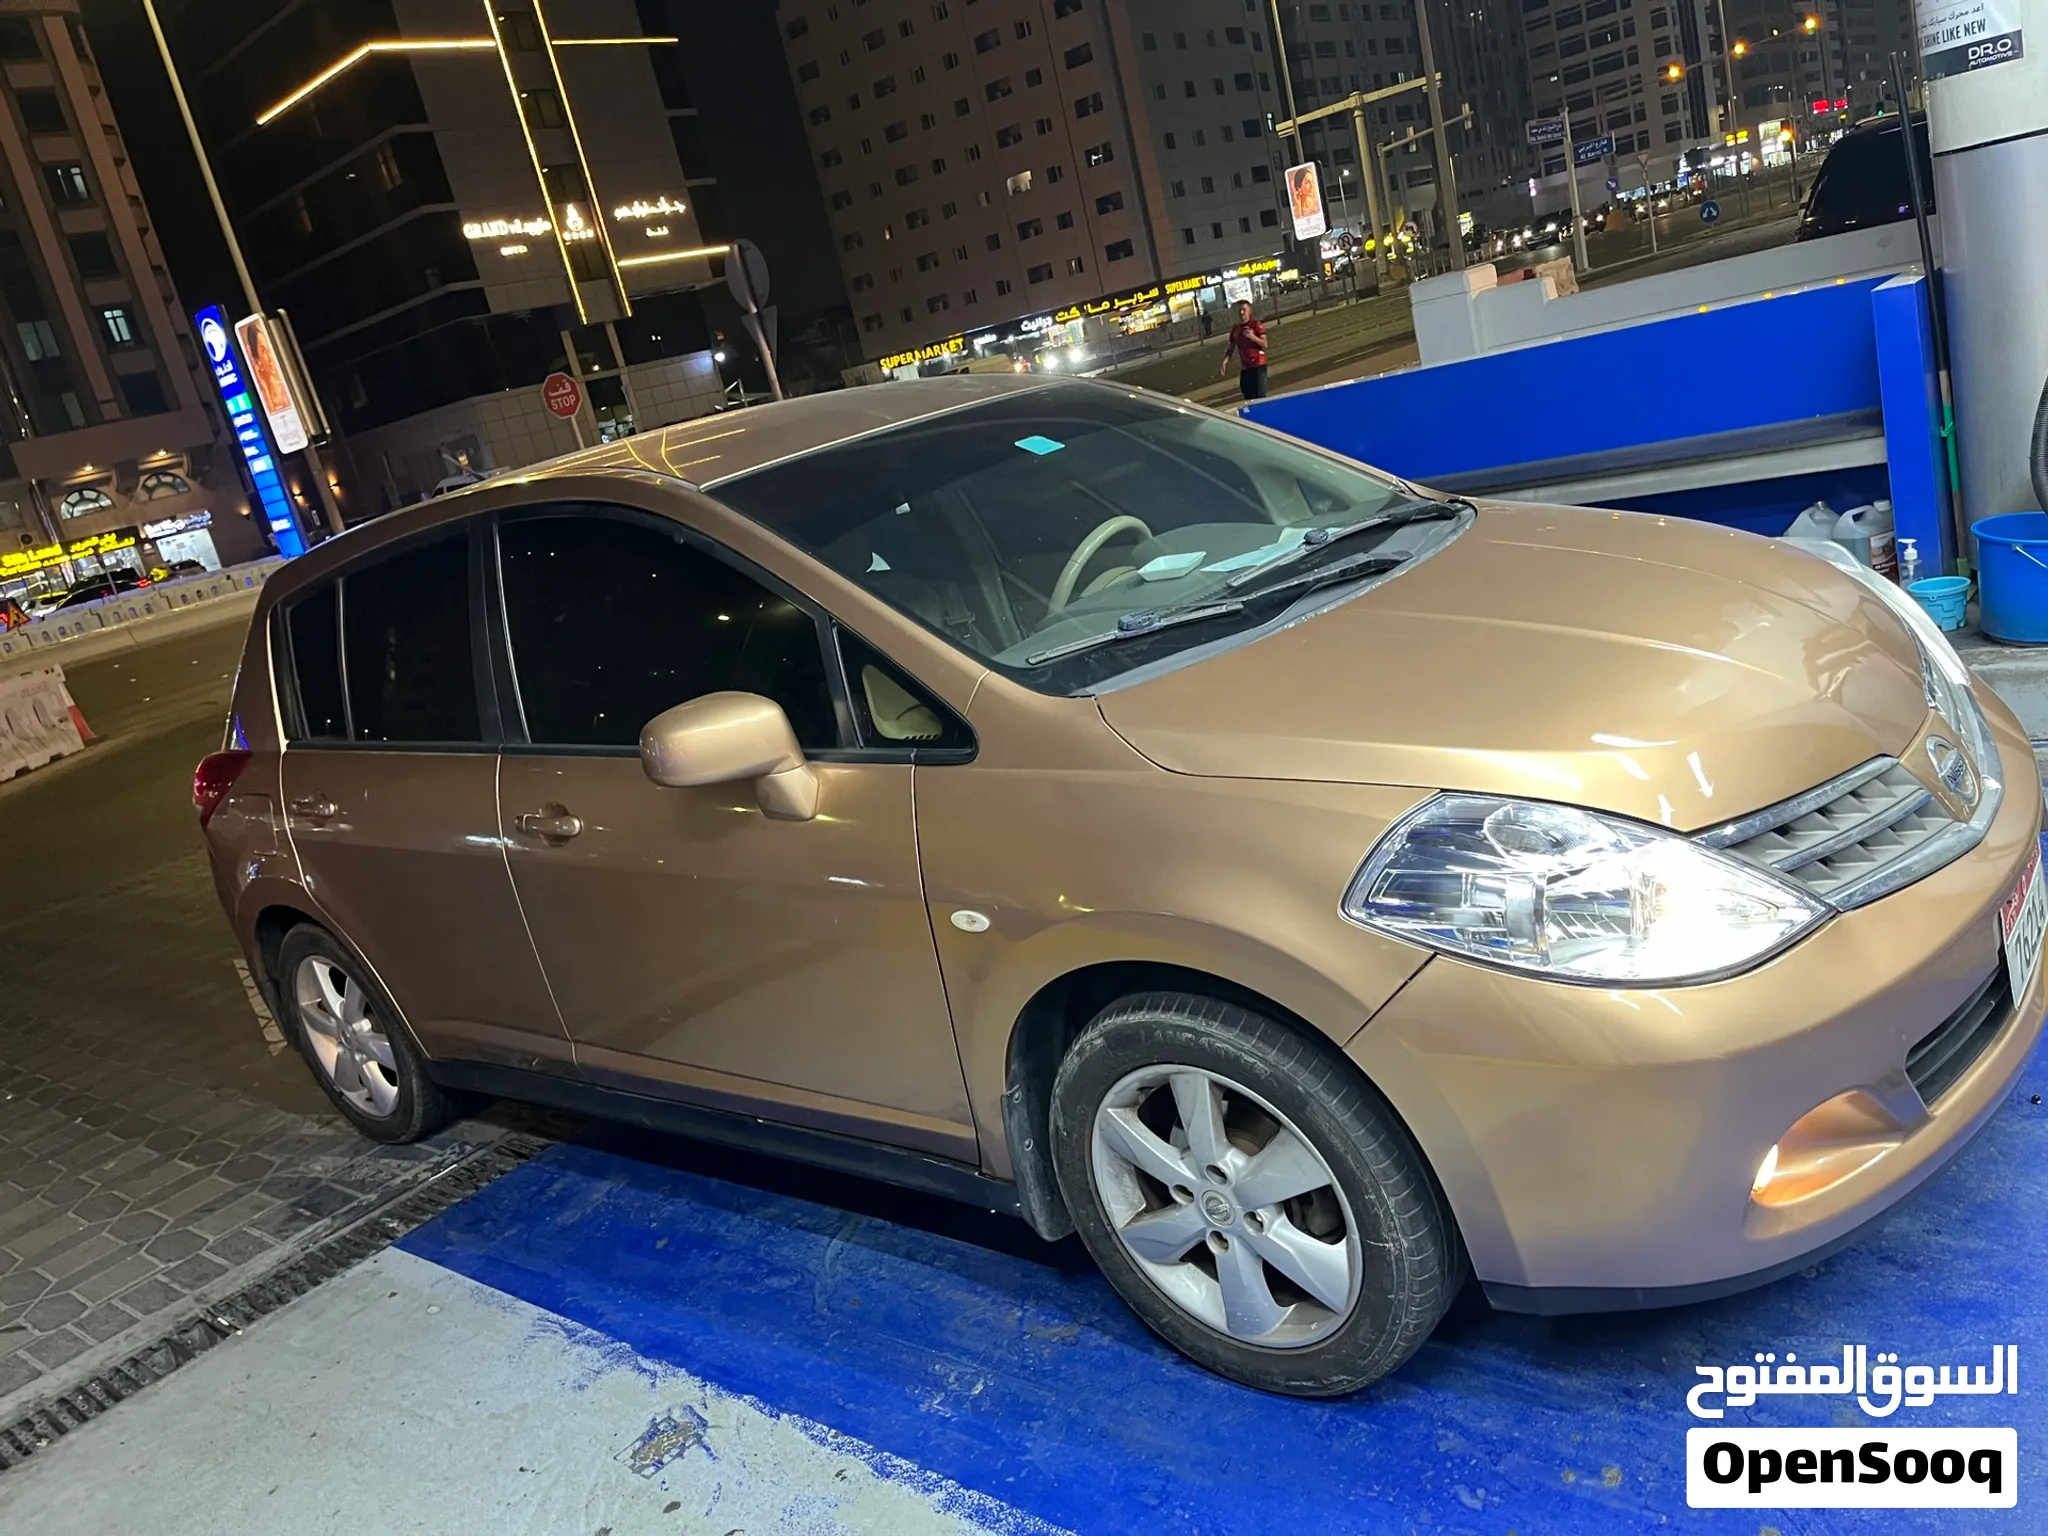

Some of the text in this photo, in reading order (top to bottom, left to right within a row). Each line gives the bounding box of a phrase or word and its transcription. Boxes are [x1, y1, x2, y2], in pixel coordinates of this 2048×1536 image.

[1942, 25, 1962, 43] LIKE
[1963, 18, 1987, 37] NEW
[1967, 38, 2012, 60] DR.O
[1968, 50, 2013, 69] AUTOMOTIVE
[550, 394, 576, 410] STOP
